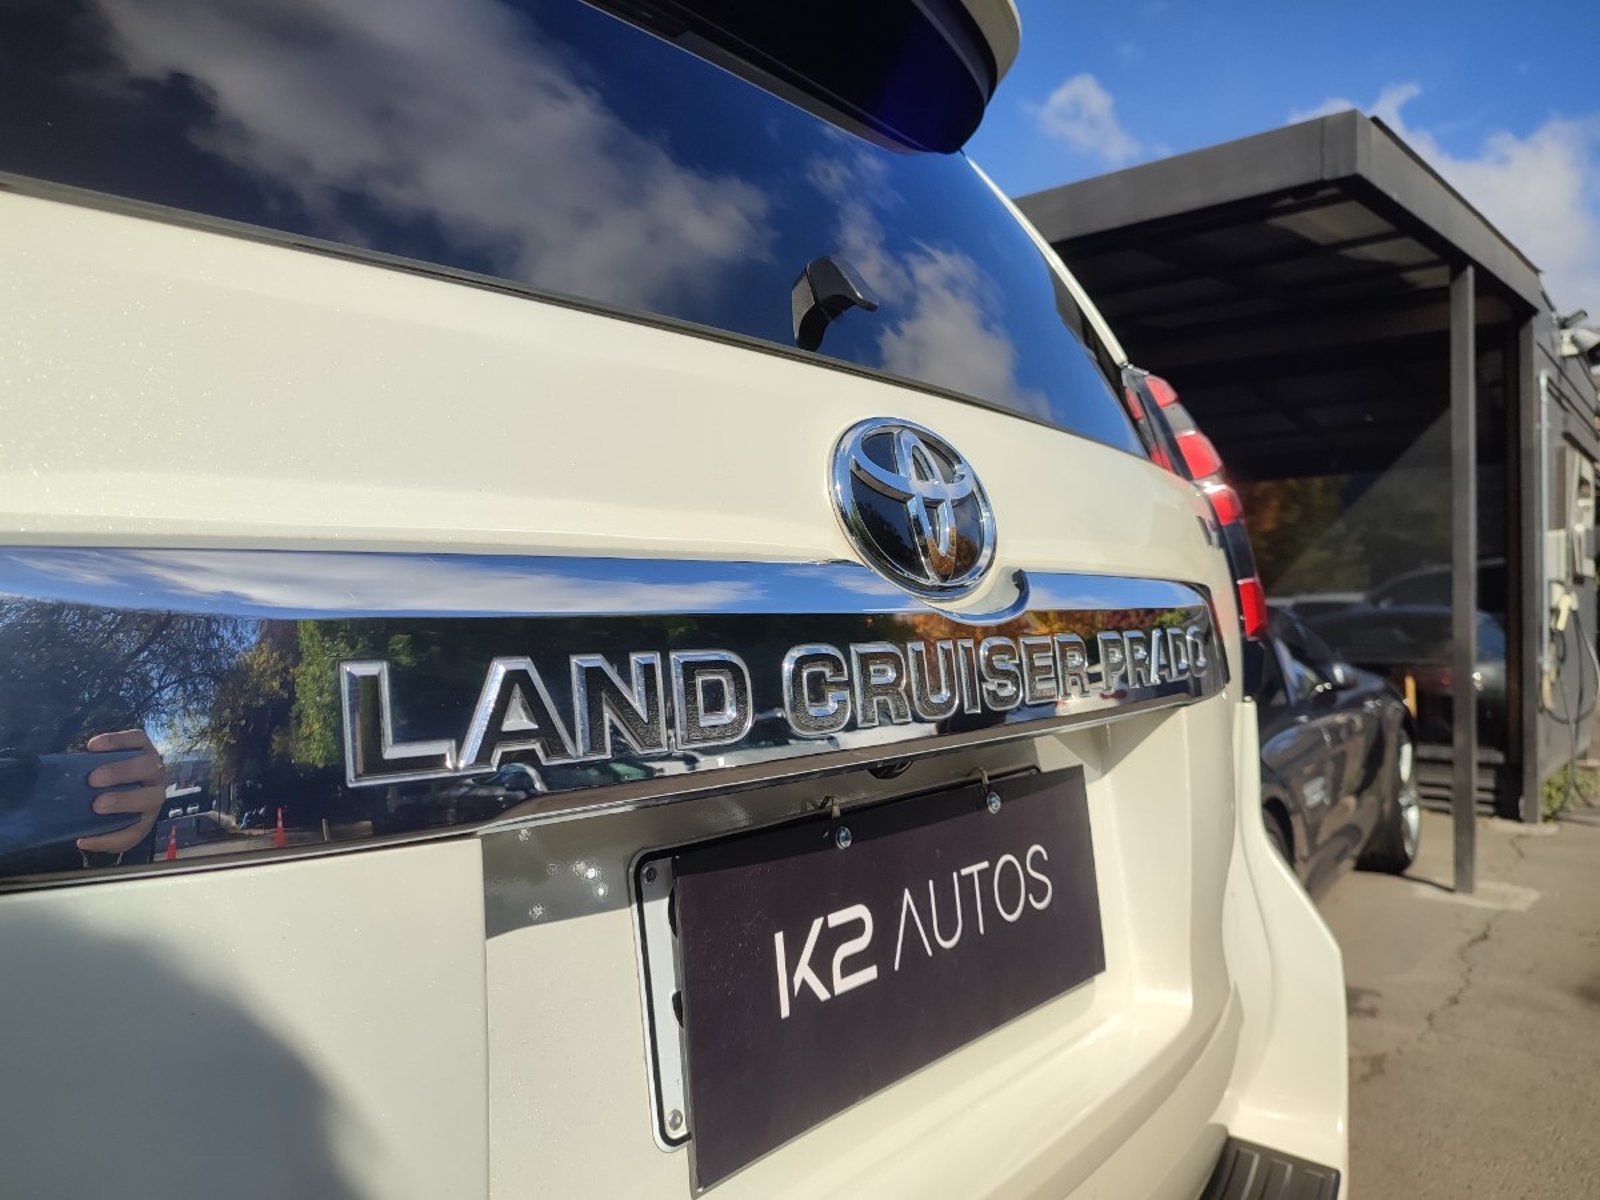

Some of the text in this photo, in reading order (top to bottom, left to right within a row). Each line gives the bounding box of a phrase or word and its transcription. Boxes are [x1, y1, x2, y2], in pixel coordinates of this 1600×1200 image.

[339, 625, 1207, 788] LAND CRUISER PRADO
[774, 844, 1053, 1019] K2 AUTOS
